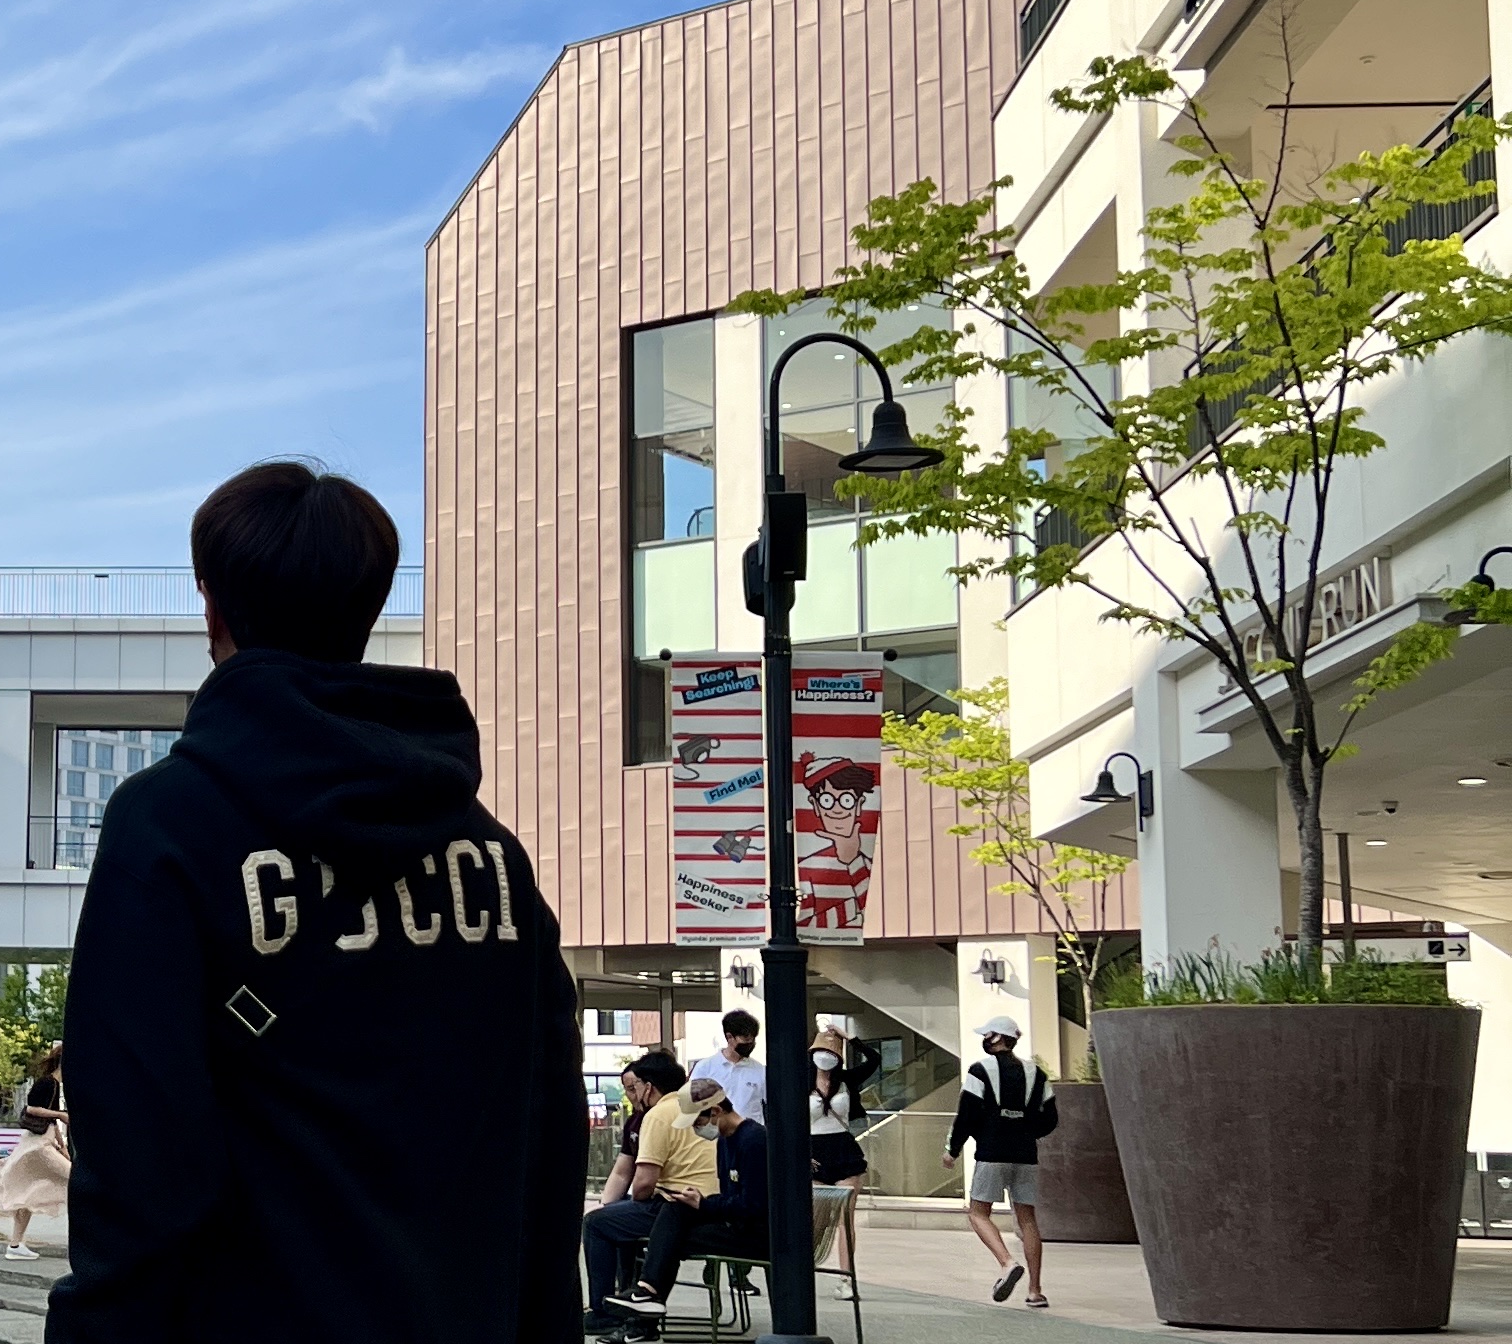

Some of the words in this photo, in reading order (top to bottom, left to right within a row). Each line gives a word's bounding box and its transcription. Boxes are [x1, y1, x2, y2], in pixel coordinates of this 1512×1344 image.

[700, 669, 734, 684] Keep
[810, 679, 860, 689] Where's
[686, 676, 755, 701] Searching!
[797, 690, 873, 702] Happiness?
[709, 782, 736, 800] Find
[737, 771, 761, 788] Me!
[678, 872, 744, 904] Happiness
[683, 889, 729, 912] Seeker
